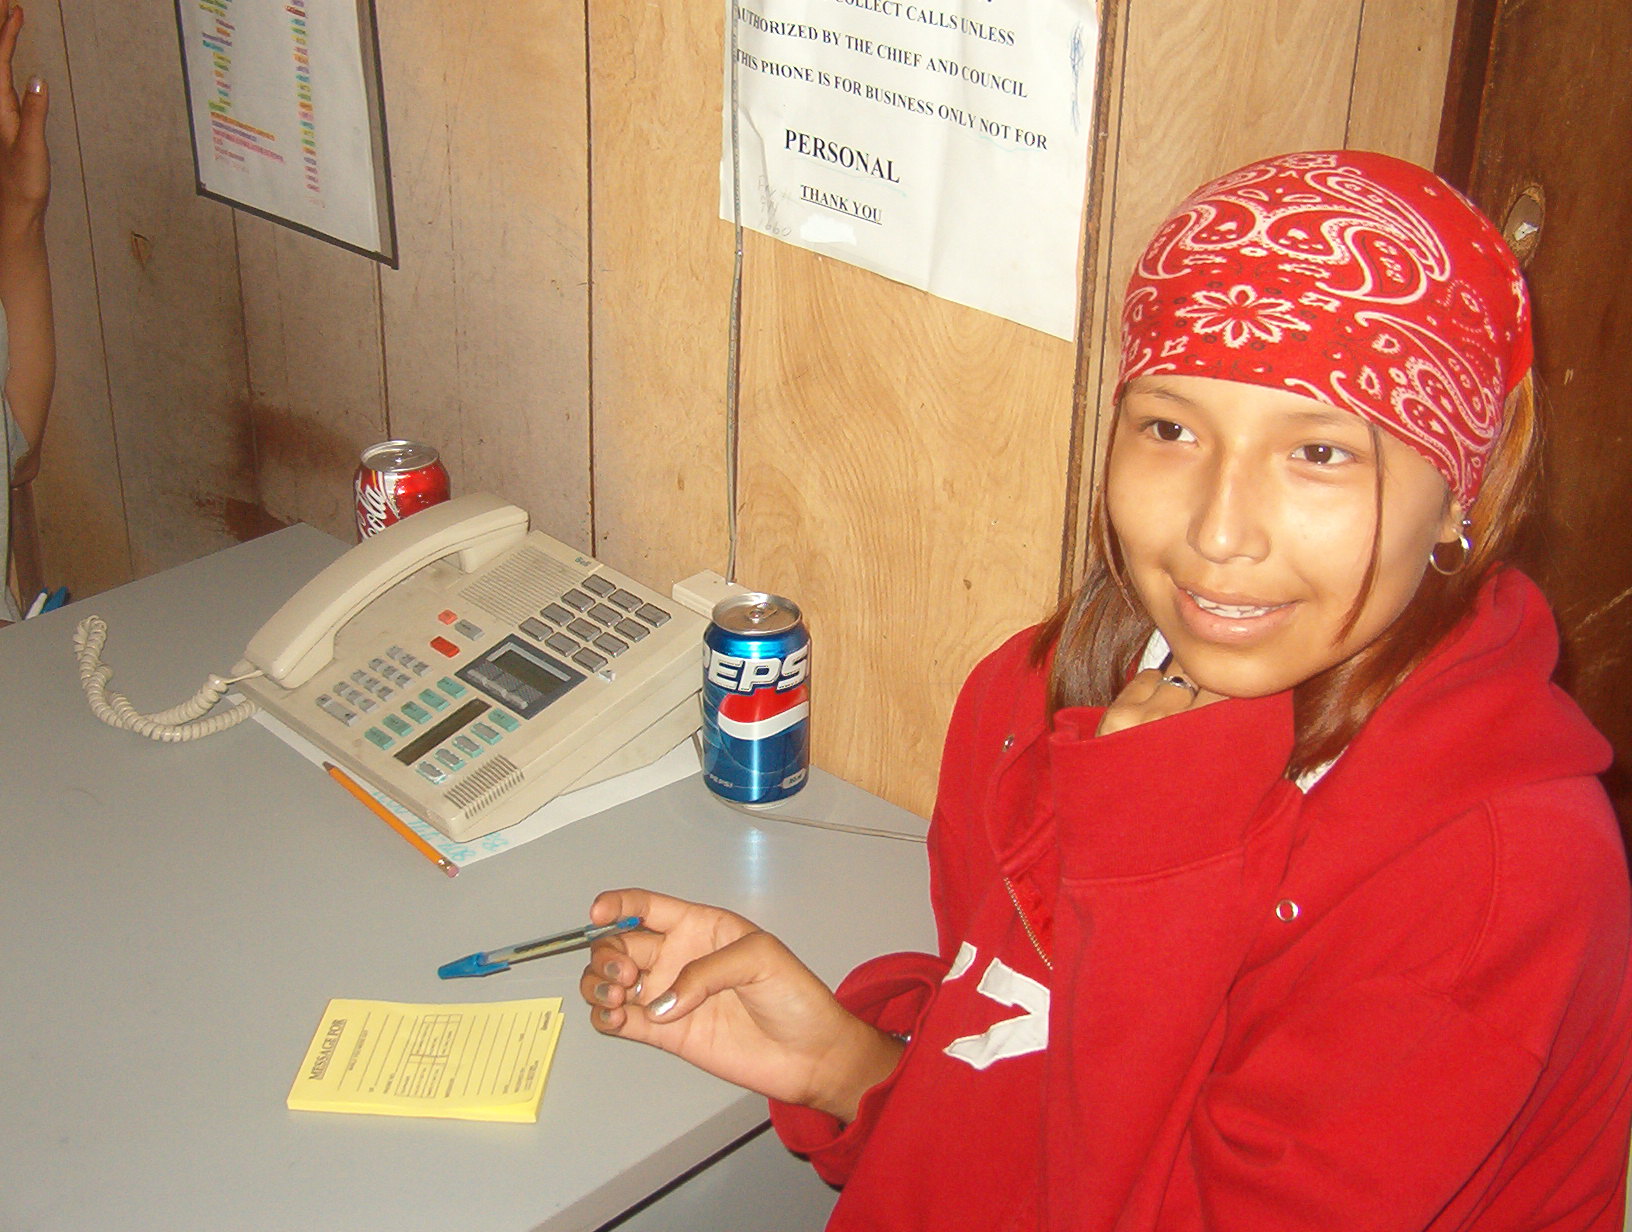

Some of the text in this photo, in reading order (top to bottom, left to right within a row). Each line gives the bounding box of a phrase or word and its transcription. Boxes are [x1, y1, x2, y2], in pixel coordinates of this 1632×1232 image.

[836, 0, 1015, 46] LLECT CALLS UNLESS
[822, 29, 842, 46] BY
[845, 34, 873, 56] THE
[877, 44, 922, 68] CHIEF
[926, 57, 959, 77] AND
[961, 65, 1028, 99] COUNCIL
[736, 48, 1047, 150] THIS PHONE IS FOR BUSINESS ONLY NOT FOR
[784, 128, 900, 184] PERSONAL
[801, 185, 848, 211] THANK
[853, 201, 883, 223] YOU
[703, 639, 811, 693] EPS
[308, 1019, 347, 1080] MESSAGE FOR
